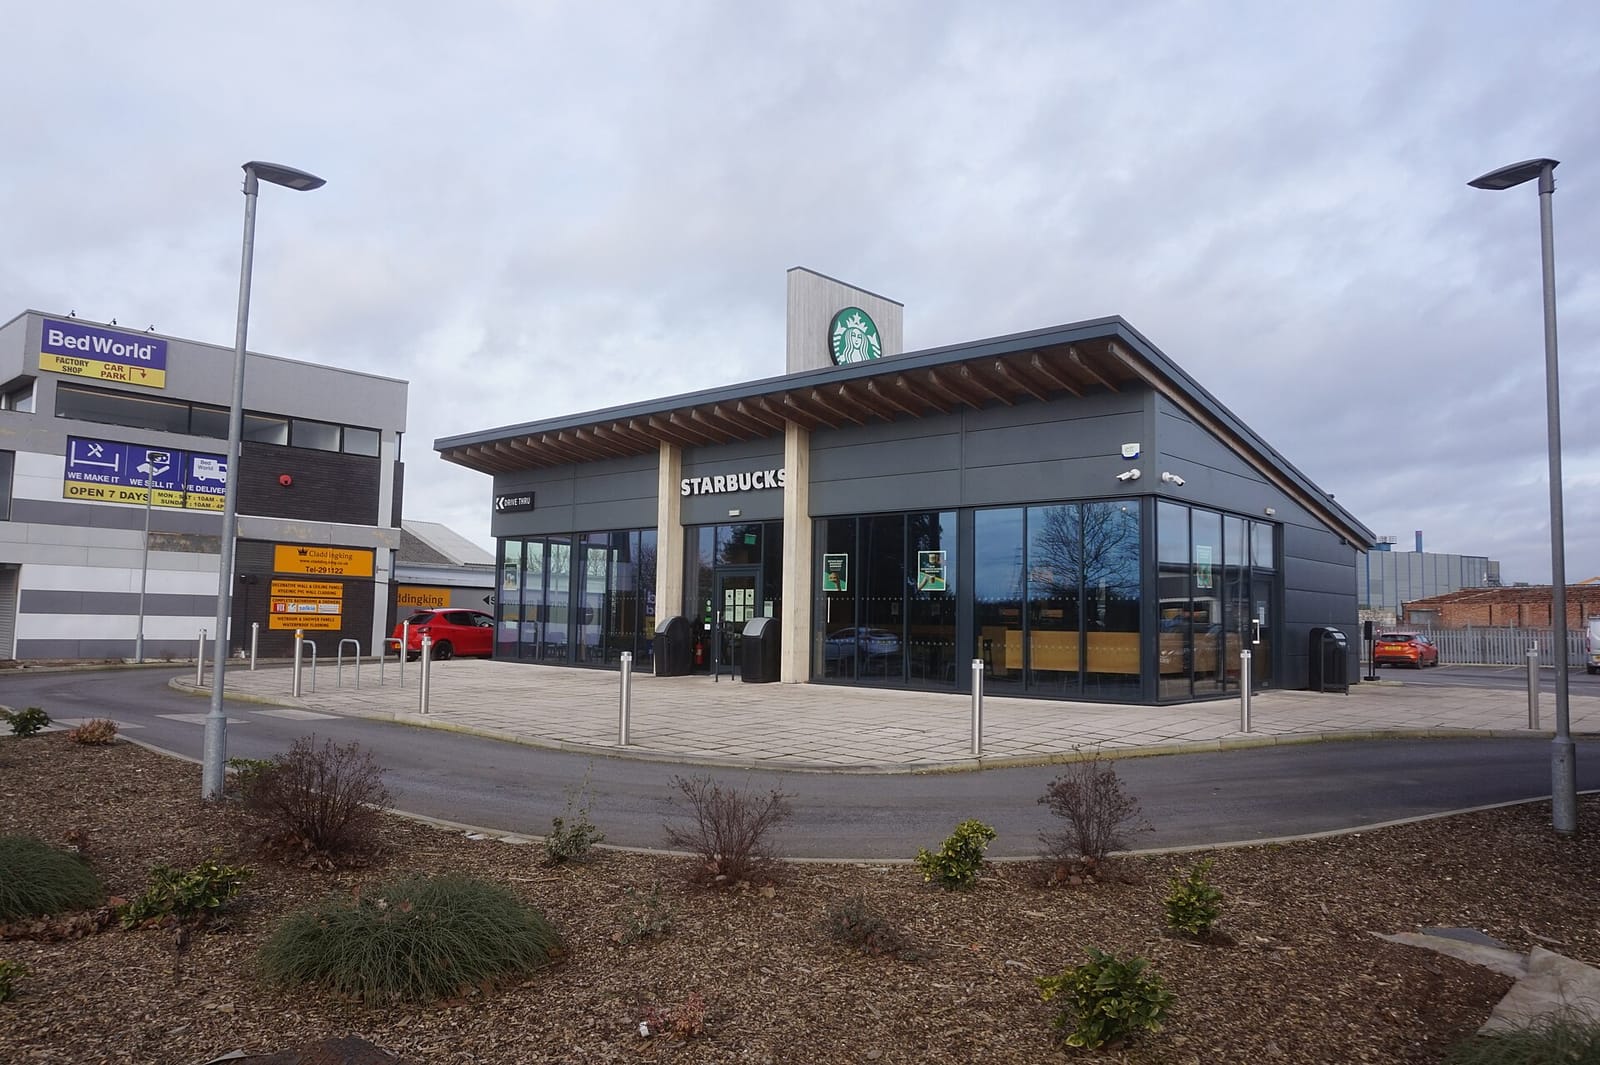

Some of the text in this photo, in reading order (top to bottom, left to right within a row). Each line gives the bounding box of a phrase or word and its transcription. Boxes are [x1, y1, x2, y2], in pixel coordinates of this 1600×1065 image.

[55, 356, 90, 367] FACTORY
[61, 365, 83, 374] SHOP
[103, 363, 124, 372] CAR
[100, 371, 126, 380] PARK
[68, 472, 82, 480] WE
[84, 473, 110, 483] MAKE
[681, 468, 785, 496] STARBUCKS
[129, 478, 143, 486] WE
[144, 480, 165, 488] SELL
[70, 486, 149, 501] OPEN 7 DAYS
[504, 497, 530, 507] DRIVE THRU
